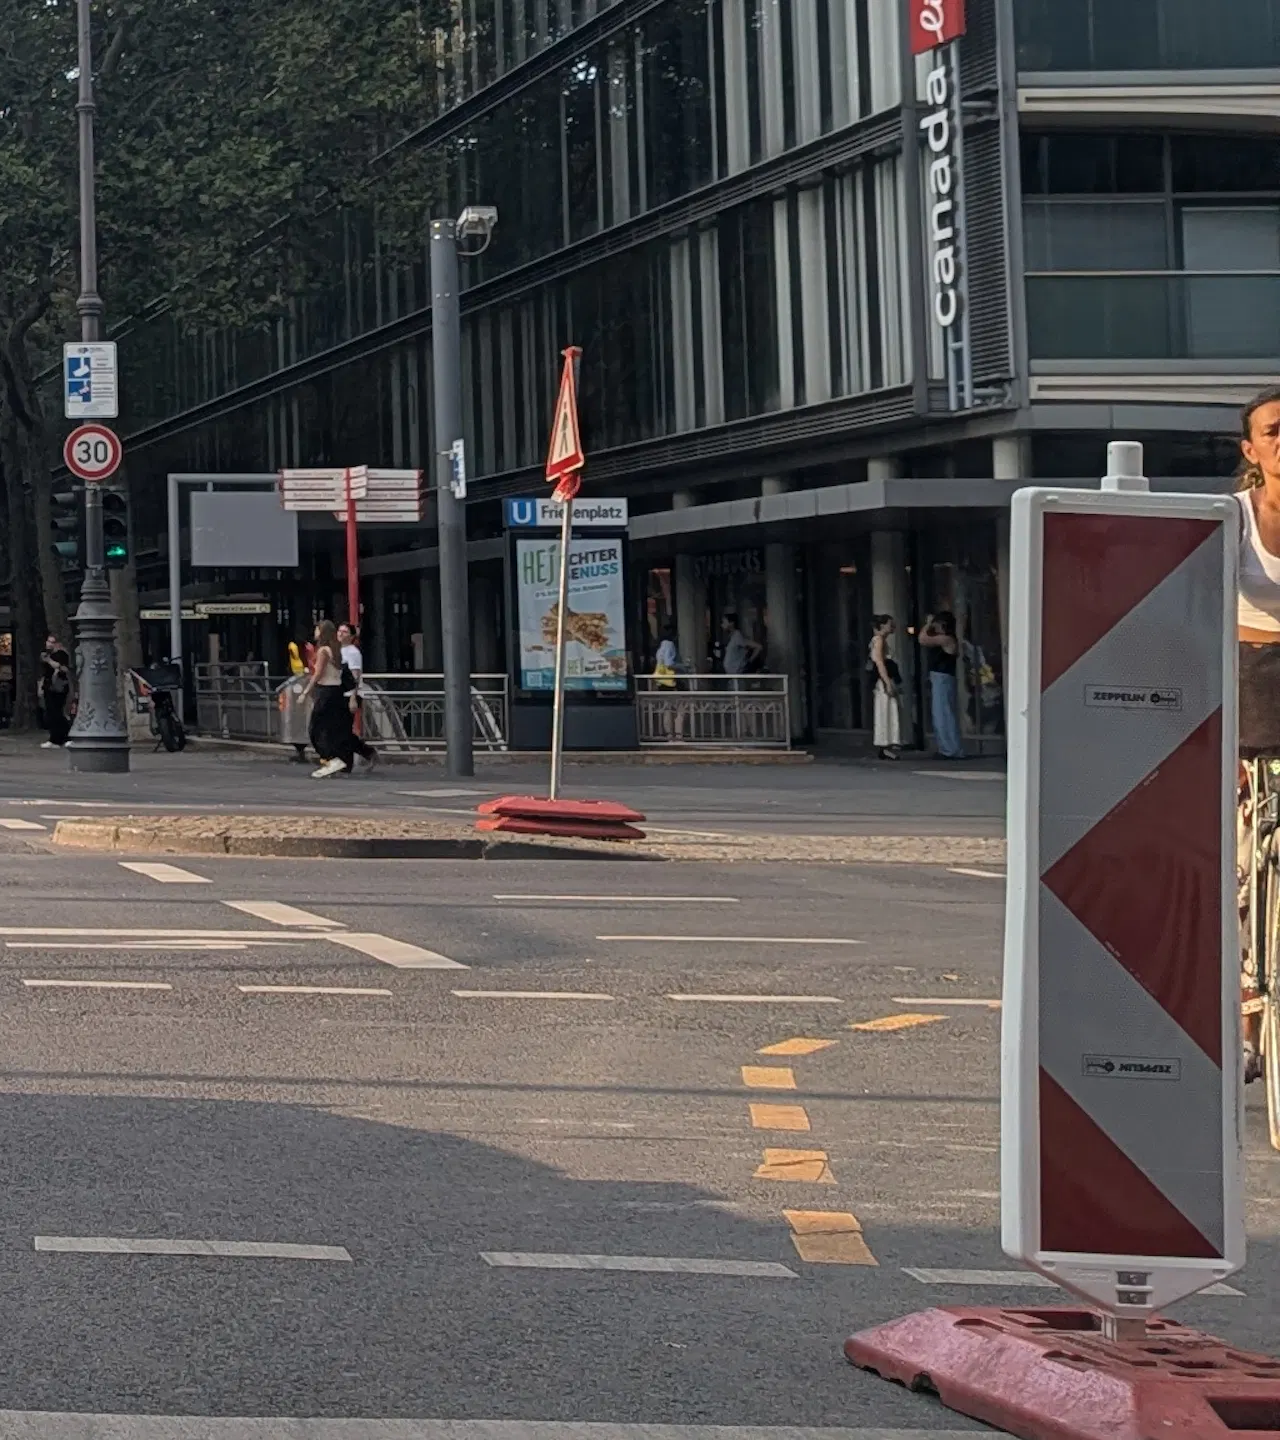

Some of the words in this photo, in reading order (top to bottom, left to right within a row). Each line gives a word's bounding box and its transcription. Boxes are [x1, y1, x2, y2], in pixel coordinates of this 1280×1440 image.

[920, 65, 957, 328] canada
[77, 440, 108, 464] 30
[512, 501, 532, 524] U
[541, 504, 622, 521] Frieenplatz
[568, 548, 618, 567] CHTER
[568, 562, 619, 580] ENUSS
[1092, 691, 1146, 702] ZEPPELIN
[1118, 1063, 1172, 1075] ZEPPELIN
